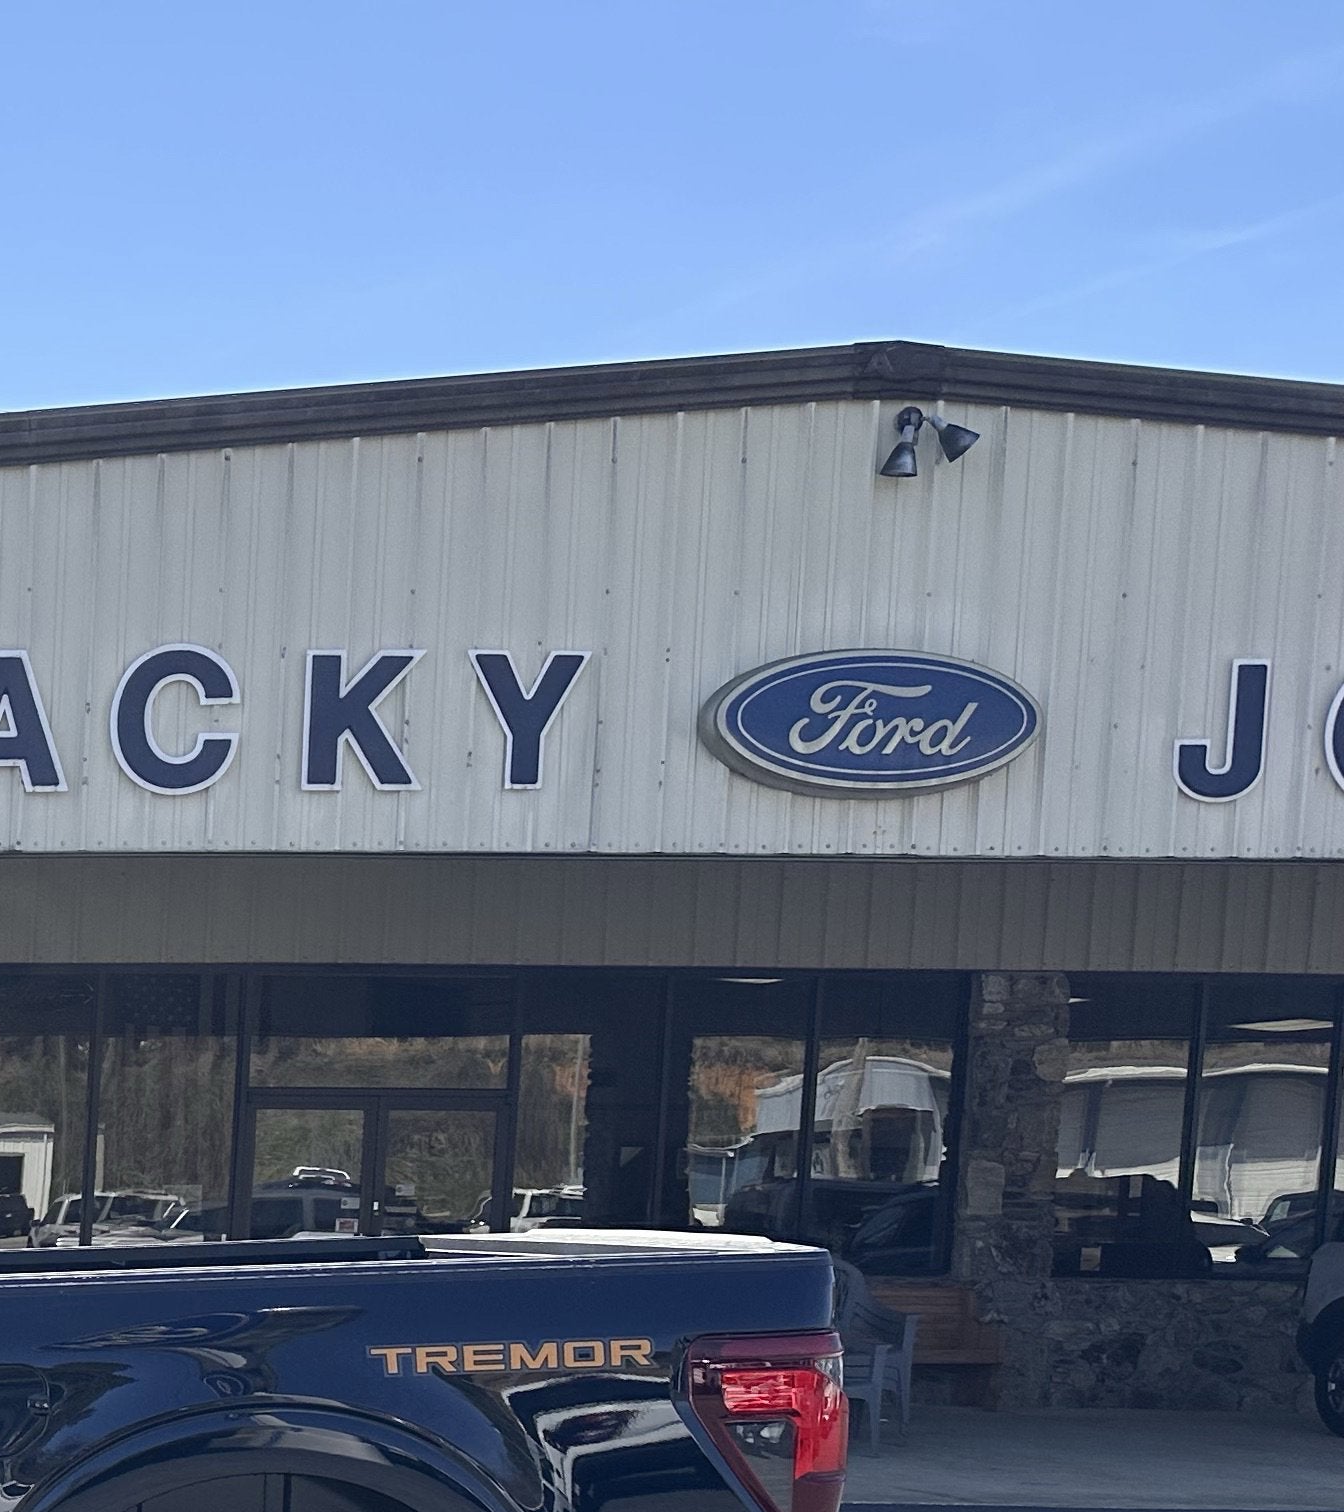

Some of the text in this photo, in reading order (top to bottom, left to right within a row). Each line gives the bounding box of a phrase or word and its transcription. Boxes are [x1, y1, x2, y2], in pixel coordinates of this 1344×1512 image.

[789, 680, 979, 755] Ford
[1173, 655, 1344, 804] J
[368, 1337, 655, 1377] TREMOR
